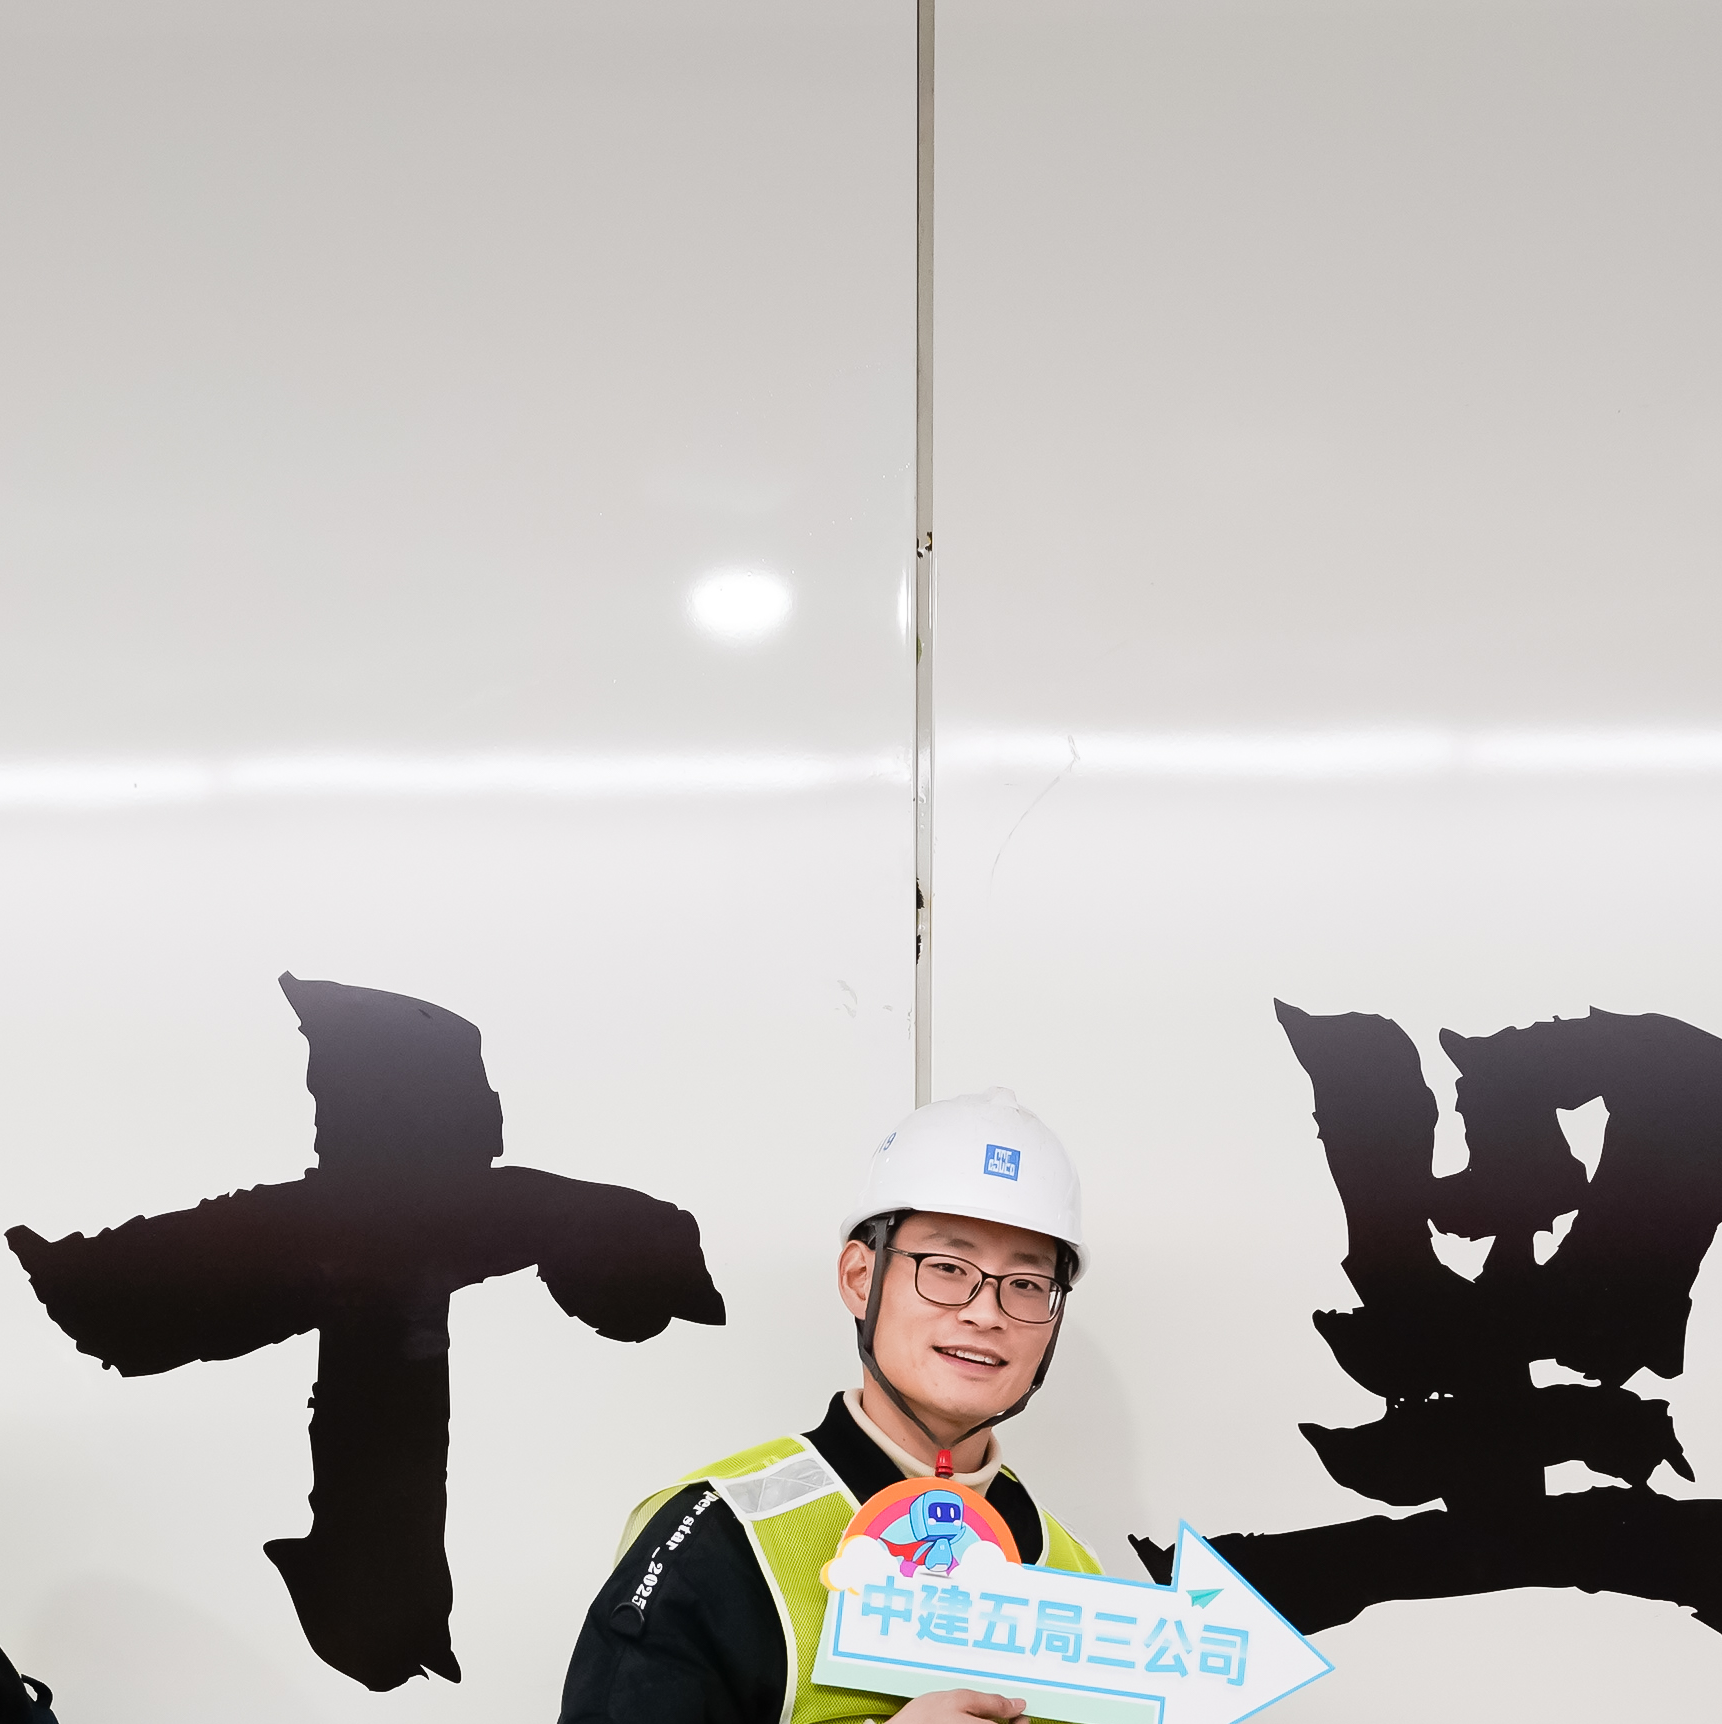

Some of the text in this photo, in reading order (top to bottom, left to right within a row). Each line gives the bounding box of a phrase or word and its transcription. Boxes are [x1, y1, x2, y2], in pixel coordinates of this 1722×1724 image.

[693, 1490, 720, 1515] per
[859, 1574, 1251, 1687] 中建五局三公司
